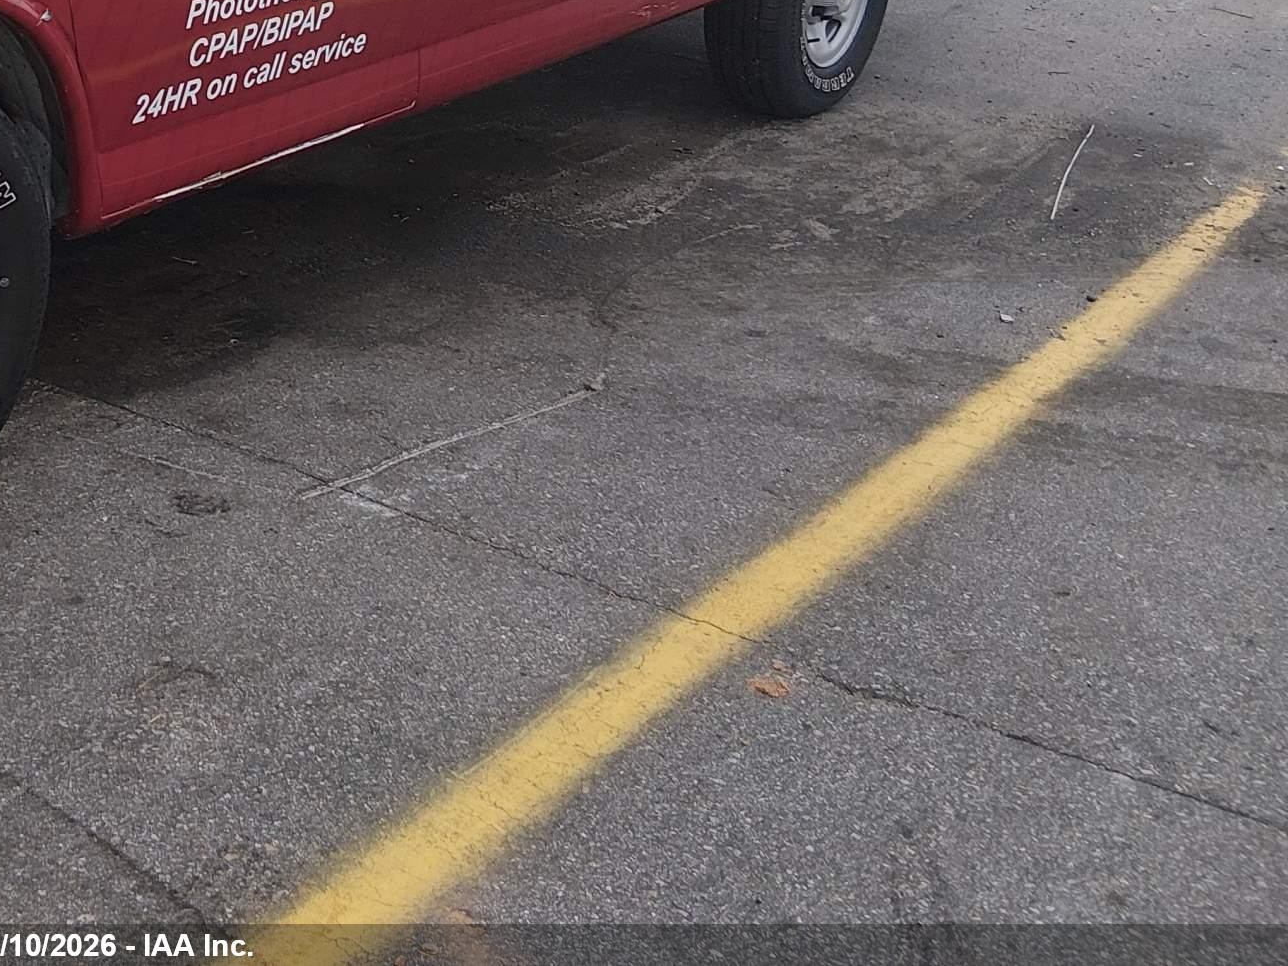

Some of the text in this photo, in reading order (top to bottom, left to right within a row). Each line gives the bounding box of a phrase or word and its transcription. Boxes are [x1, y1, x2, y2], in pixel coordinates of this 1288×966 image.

[189, 0, 335, 69] CPAP/BIPAP
[131, 32, 367, 125] 24HR on call service
